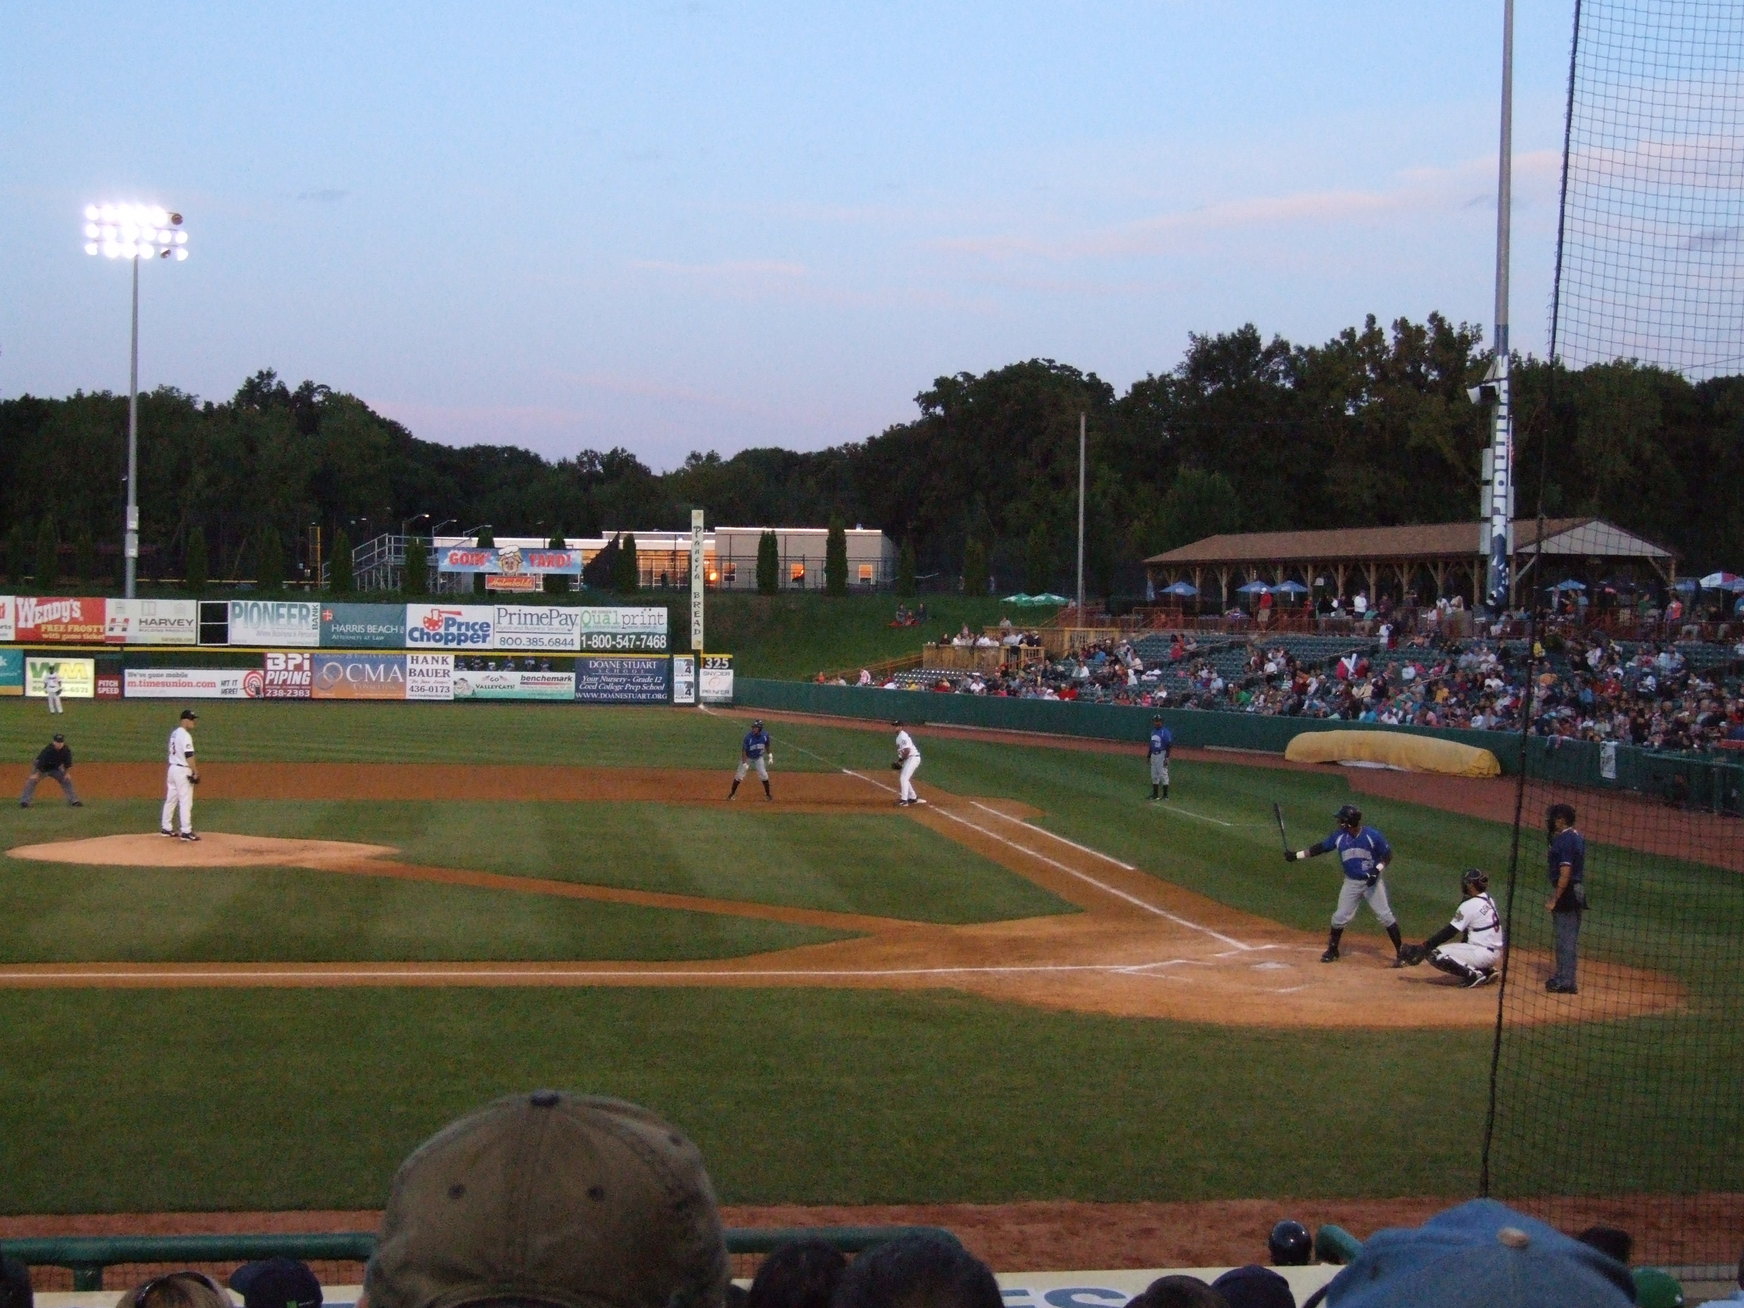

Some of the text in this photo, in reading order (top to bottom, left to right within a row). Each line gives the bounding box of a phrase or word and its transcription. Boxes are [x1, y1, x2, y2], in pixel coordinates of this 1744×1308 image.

[693, 525, 702, 635] Panera BREAD
[231, 602, 311, 629] PIONEER
[497, 607, 579, 631] PrimePay
[138, 618, 194, 627] HARVEY
[444, 617, 491, 633] Price
[41, 624, 104, 633] FREE FROSTY
[331, 624, 365, 633] HARRIS
[367, 624, 398, 633] BEACH
[408, 626, 490, 646] Chopper
[500, 636, 574, 647] 800.385.6844
[581, 634, 667, 648] 1-800-547-7468
[410, 655, 449, 665] HANK
[589, 660, 657, 669] DOANE STUART
[704, 657, 729, 669] 325
[408, 668, 450, 678] BAUER
[265, 671, 311, 685] PIPING
[520, 674, 573, 682] benchemark
[600, 676, 628, 684] Nursery
[127, 680, 216, 688] m.timesunion.com
[598, 683, 622, 691] College
[624, 683, 641, 692] Prep
[266, 689, 310, 697] 238-2383
[409, 685, 450, 693] 436-0173
[575, 692, 668, 700] WWW.DOANESTUART.ORG
